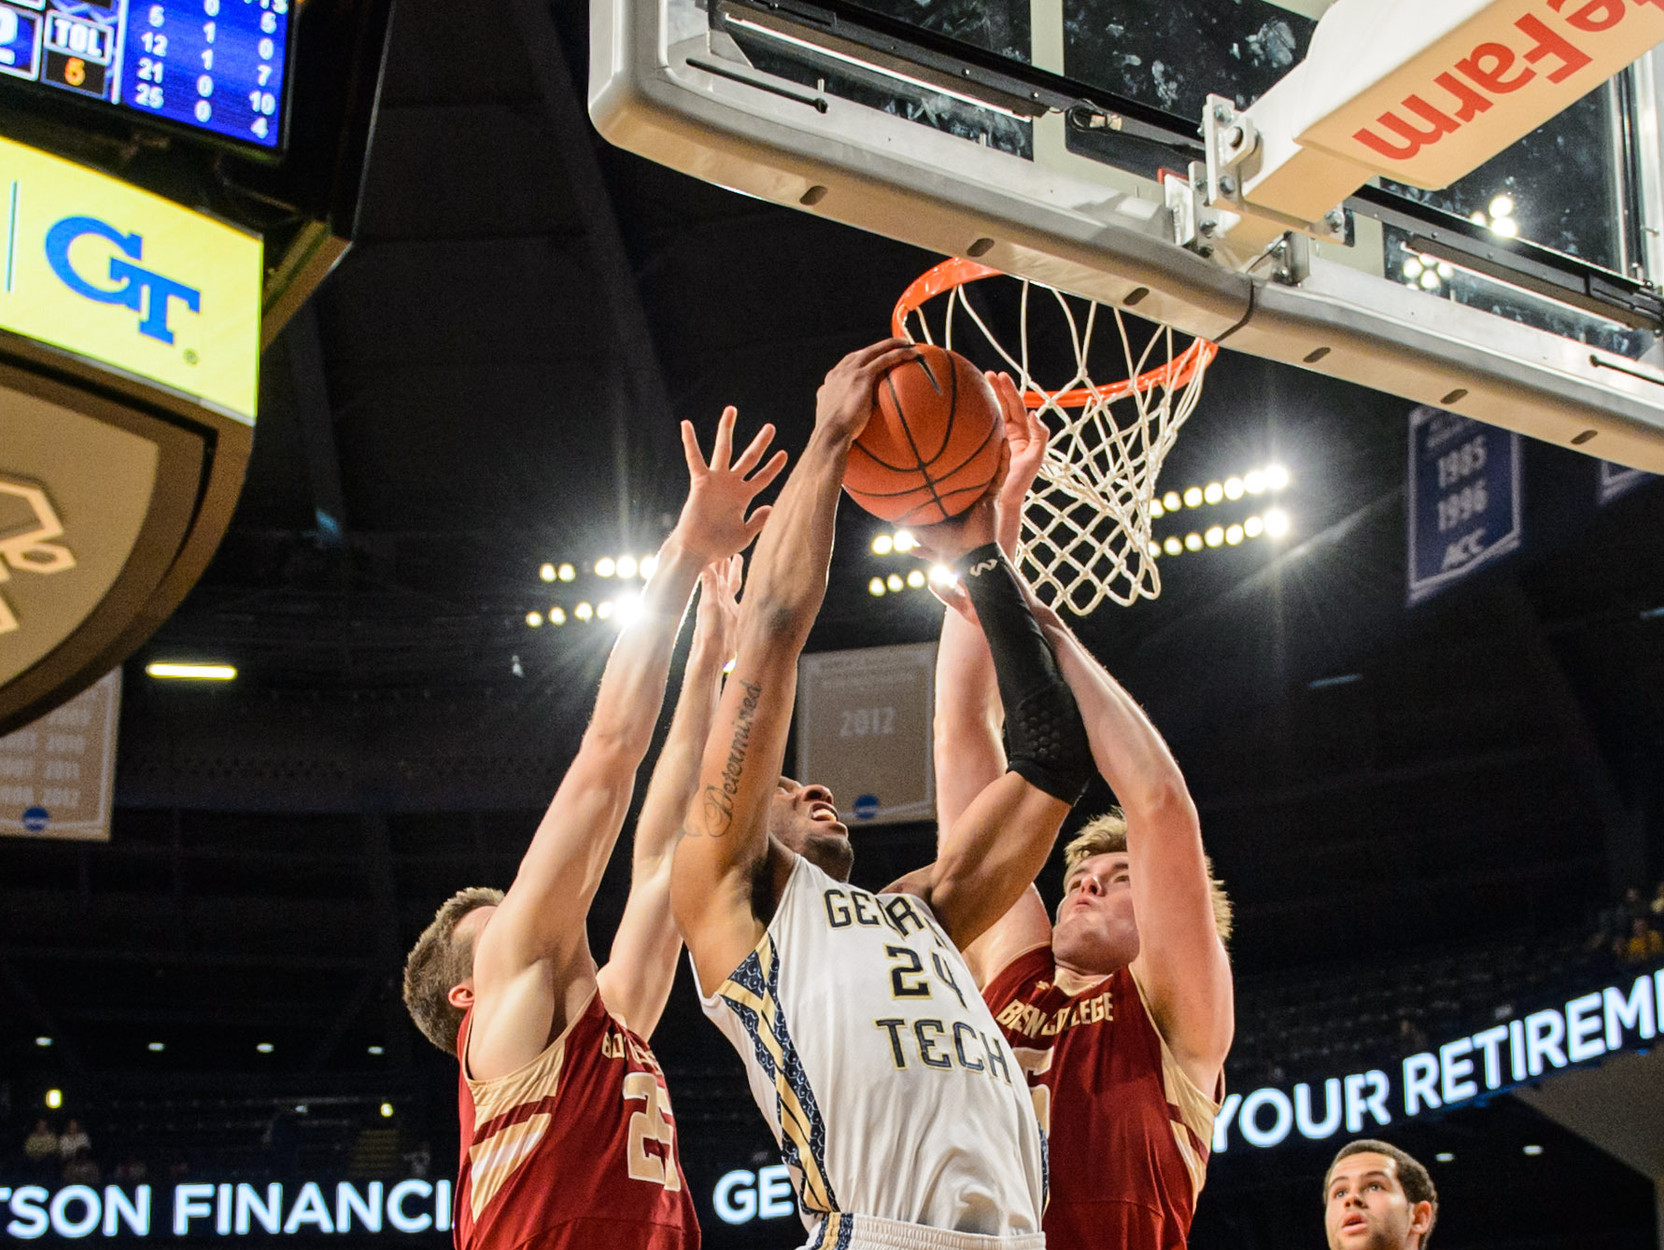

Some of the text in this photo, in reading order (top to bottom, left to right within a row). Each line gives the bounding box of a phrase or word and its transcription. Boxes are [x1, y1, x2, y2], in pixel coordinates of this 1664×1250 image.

[55, 19, 102, 57] TOL
[141, 32, 273, 87] 12 1 7
[203, 22, 216, 44] 1
[258, 38, 274, 60] 0
[137, 57, 276, 116] 21 0 10
[194, 100, 212, 123] 0
[250, 117, 269, 139] 4
[45, 215, 201, 345] GT
[1442, 528, 1487, 570] ACC
[838, 706, 897, 737] 2012
[704, 679, 762, 838] Determined
[884, 943, 967, 1009] 24
[873, 1017, 1014, 1086] TECH
[1212, 1068, 1392, 1154] YOUR
[172, 1178, 452, 1235] FINANCI
[712, 1163, 795, 1226] GE
